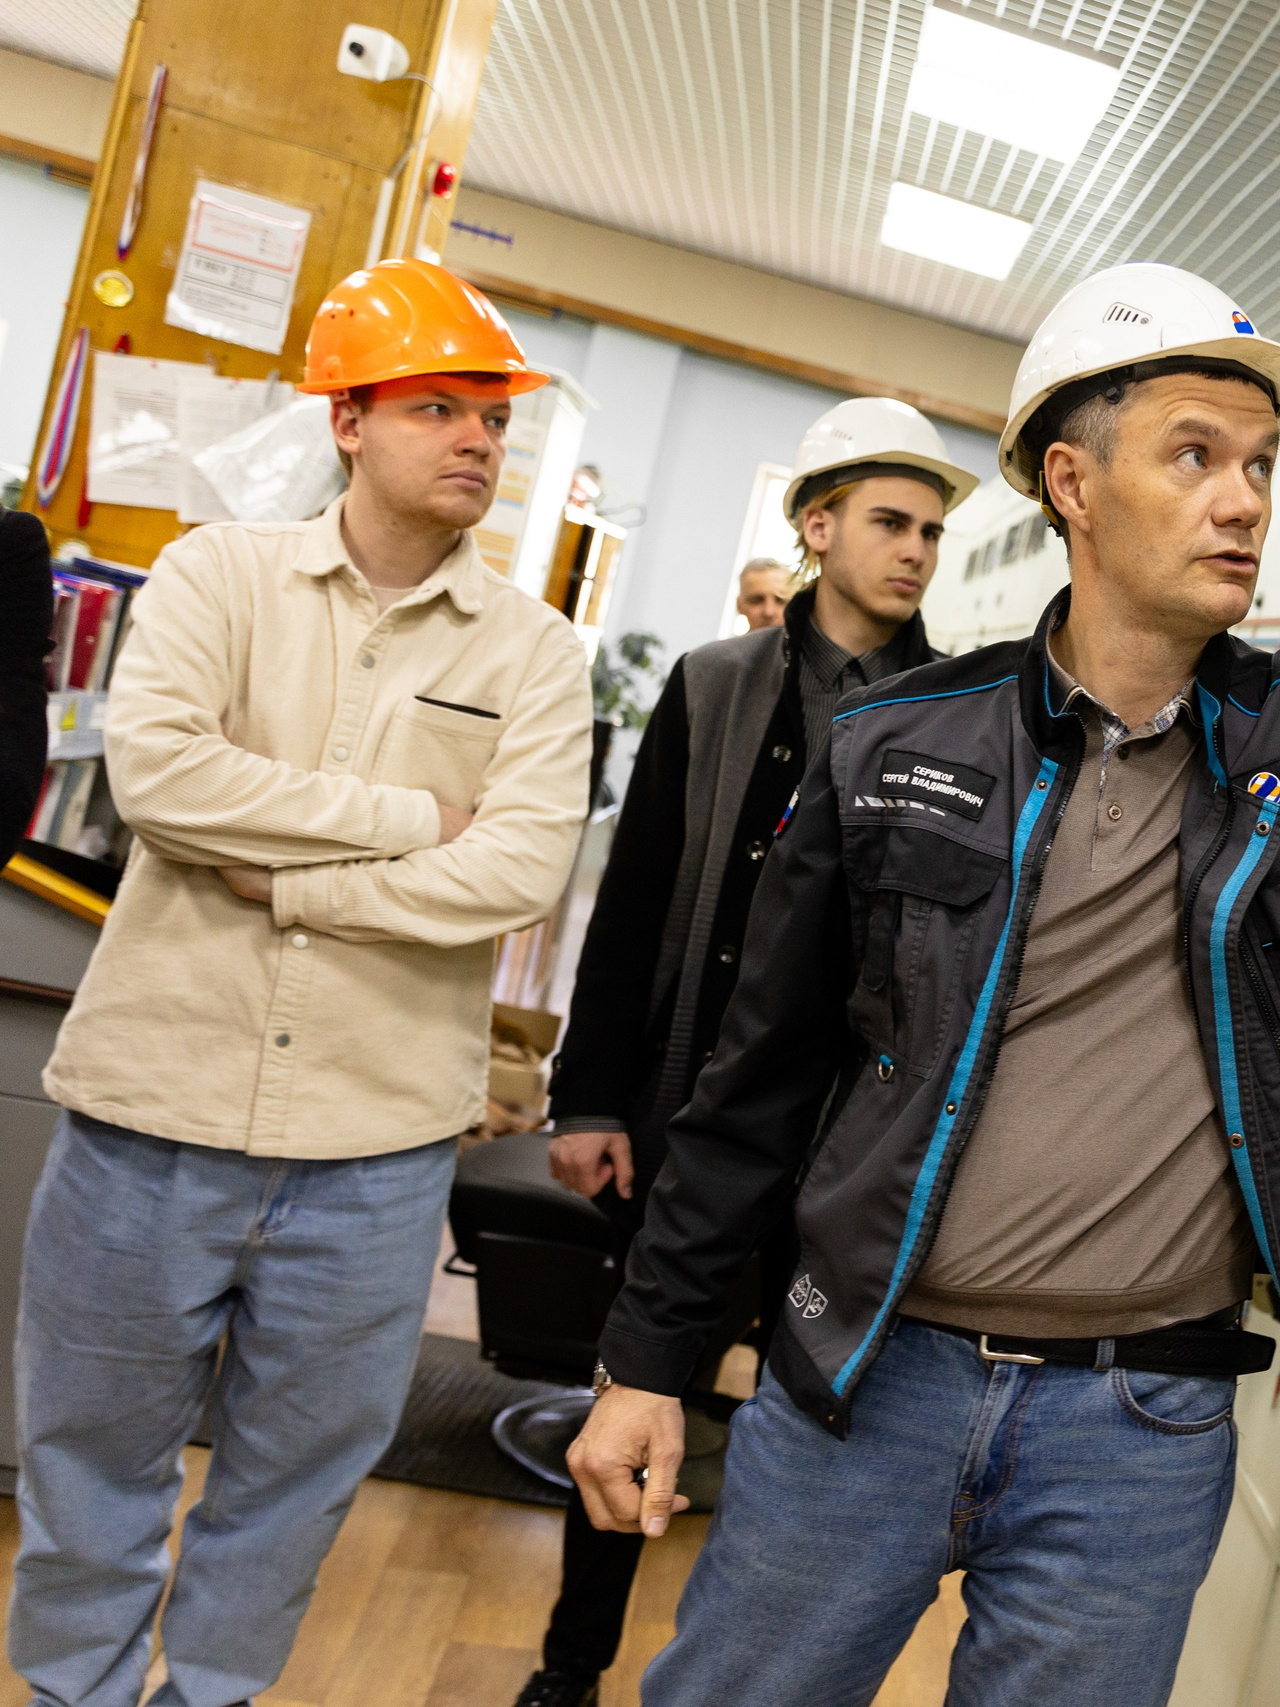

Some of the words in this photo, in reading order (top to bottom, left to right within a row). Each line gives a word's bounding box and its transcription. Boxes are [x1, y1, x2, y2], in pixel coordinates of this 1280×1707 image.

[912, 765, 955, 783] СЕРИКОВ
[882, 773, 910, 784] СЕРГЕЙ
[911, 776, 984, 808] ВЛАДИМИРОВИЧ
